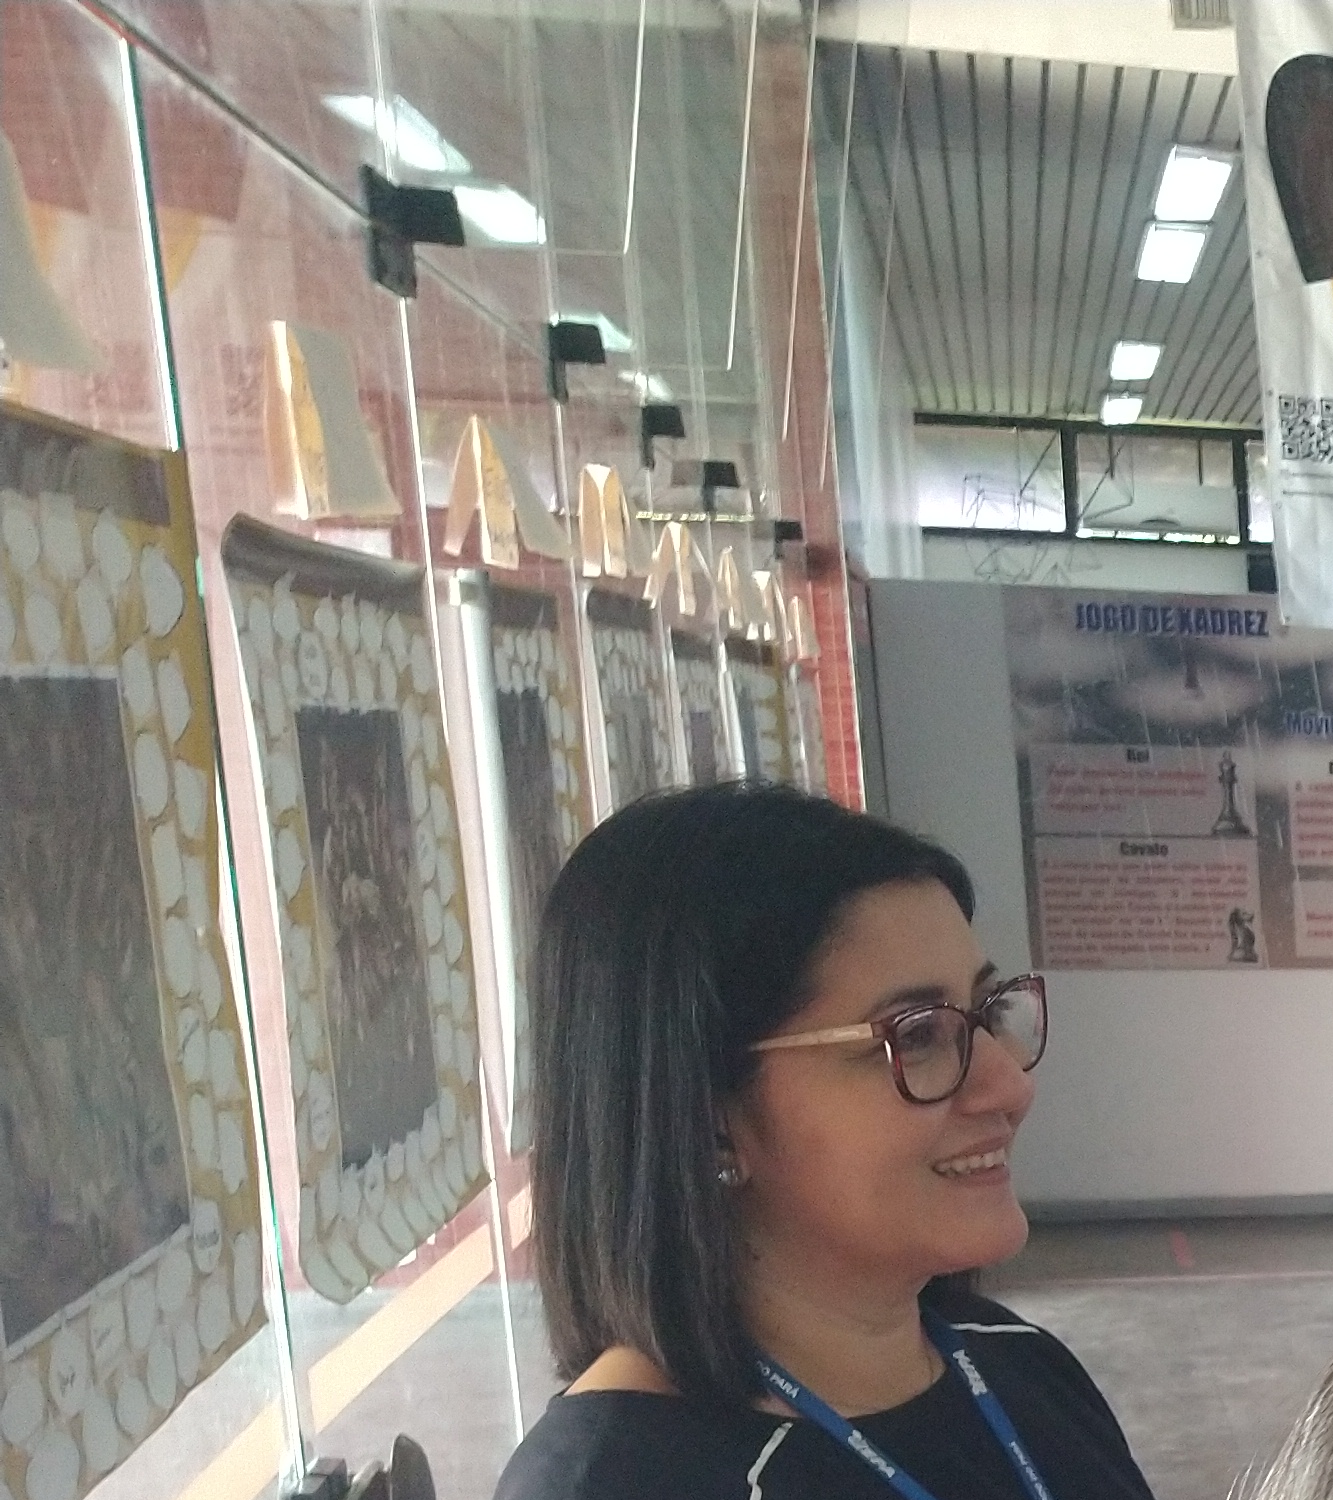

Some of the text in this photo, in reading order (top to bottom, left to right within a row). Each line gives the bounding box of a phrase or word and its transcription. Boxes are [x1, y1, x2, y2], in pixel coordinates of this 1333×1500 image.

[1076, 602, 1270, 637] JOGO DE XADREZ
